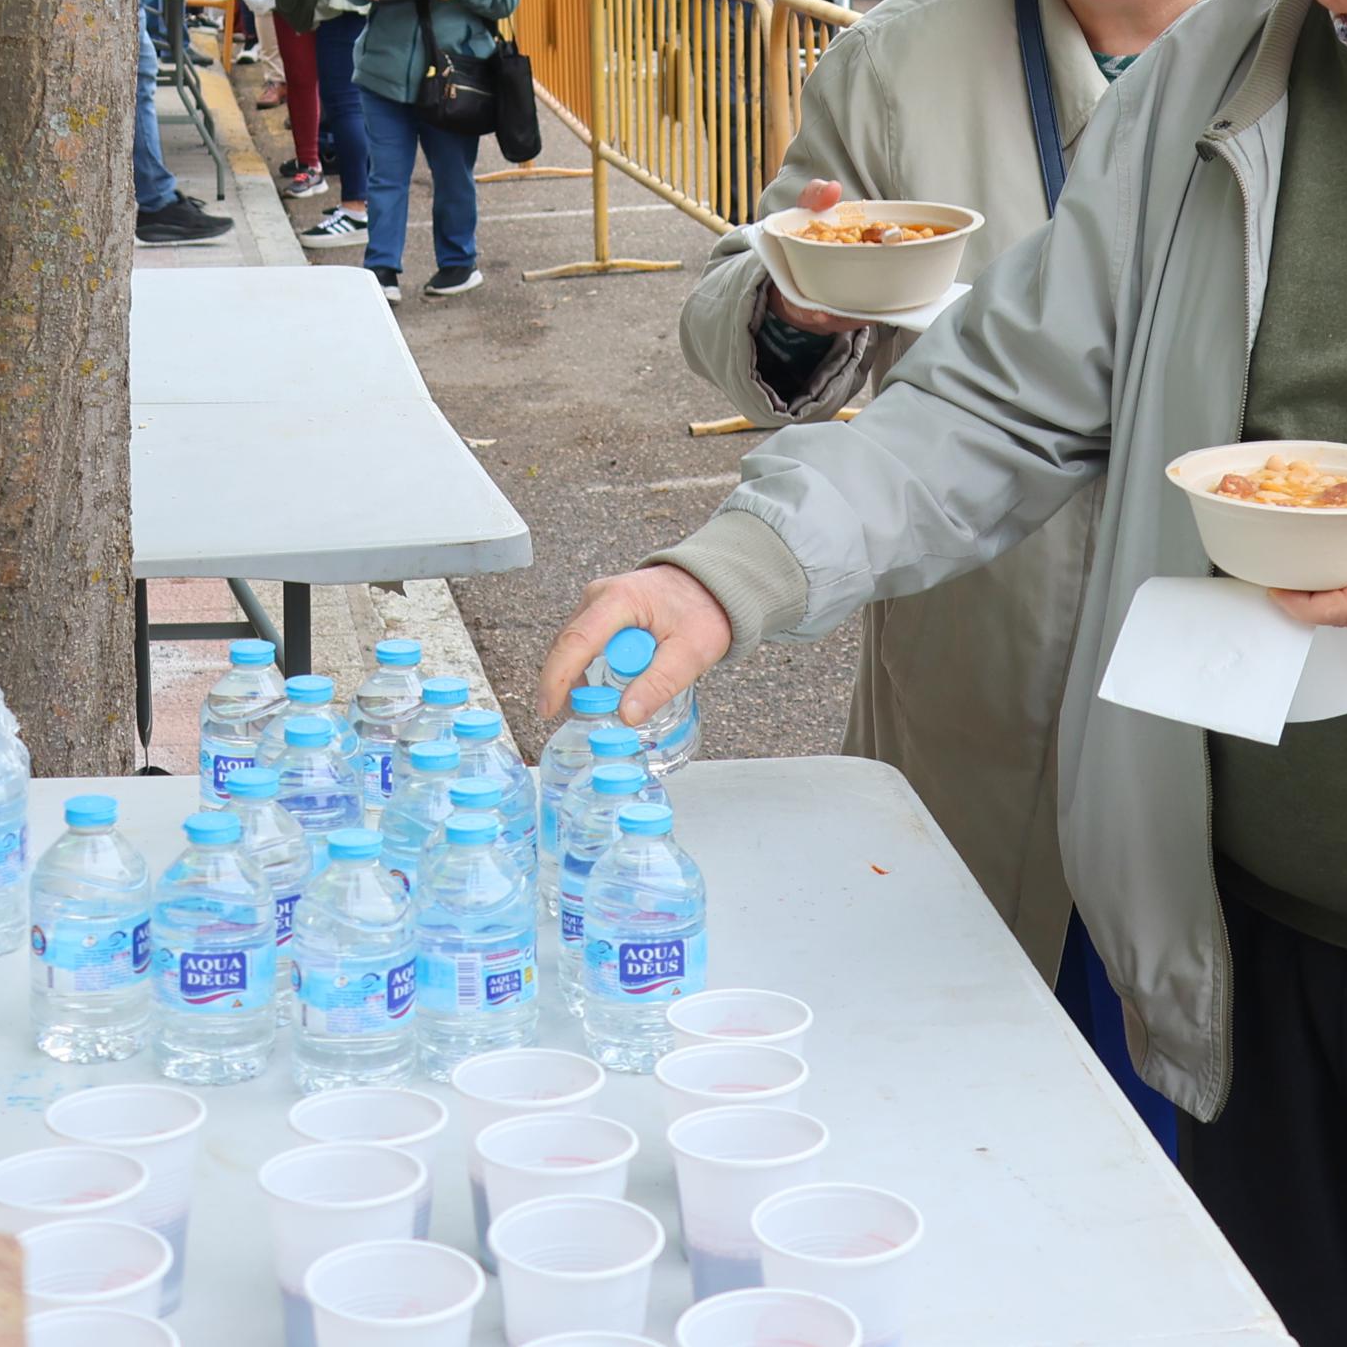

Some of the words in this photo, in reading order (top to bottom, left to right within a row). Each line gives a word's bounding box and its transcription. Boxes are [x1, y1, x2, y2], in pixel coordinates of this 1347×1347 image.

[217, 759, 252, 771] AQU
[624, 945, 681, 962] AQUA
[184, 957, 242, 973] AQUA
[627, 960, 679, 975] DEUS
[187, 972, 240, 986] DEUS
[488, 972, 520, 986] AQUA
[490, 981, 520, 995] DEUS
